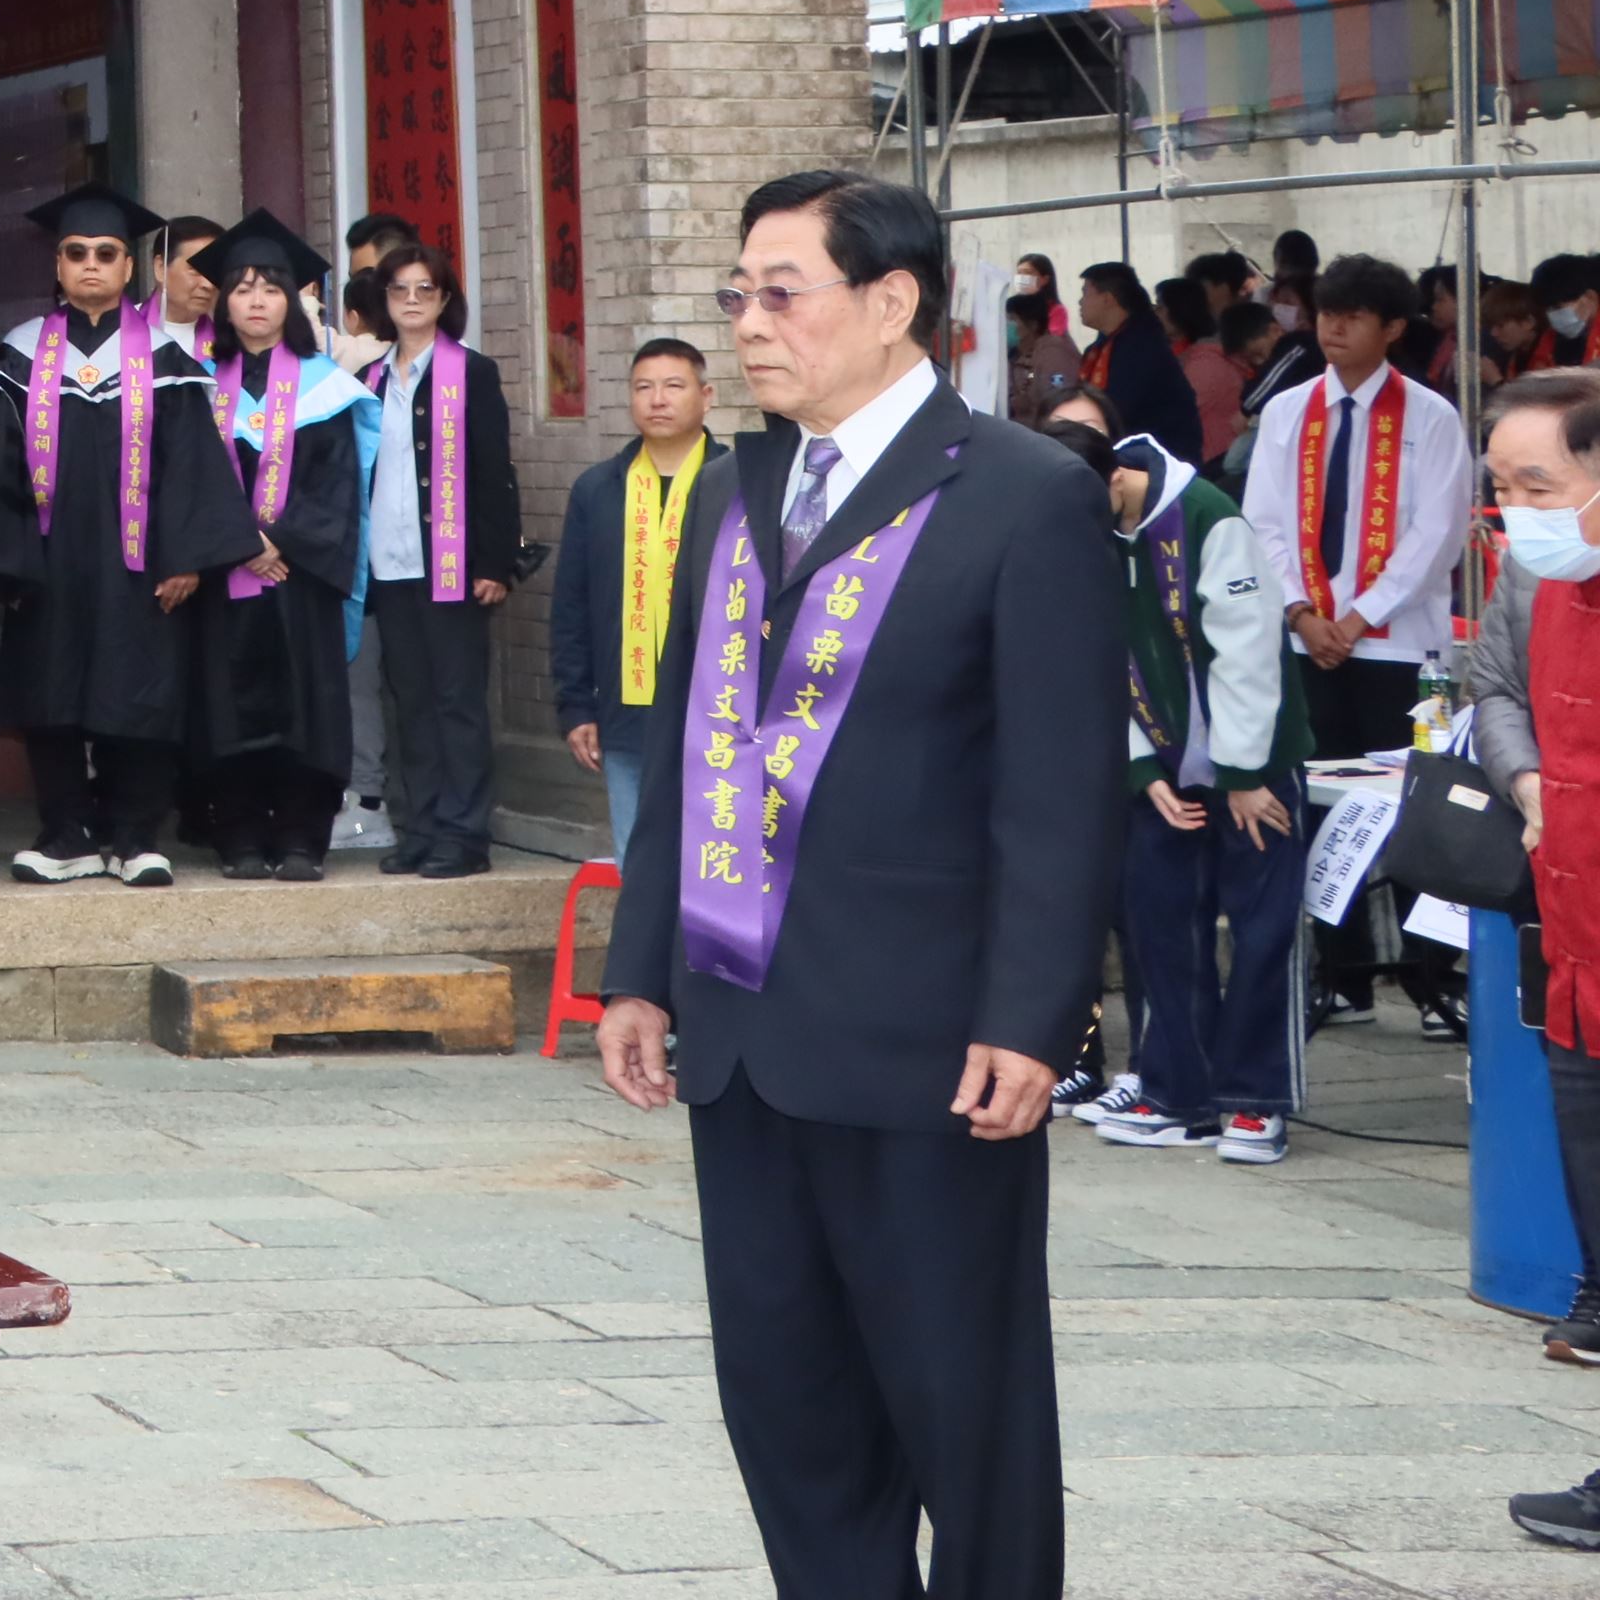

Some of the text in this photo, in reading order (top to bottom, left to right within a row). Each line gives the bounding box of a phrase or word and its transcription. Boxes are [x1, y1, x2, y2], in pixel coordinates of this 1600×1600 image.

[33, 332, 60, 454] 苗栗市文昌祠
[125, 357, 146, 507] ML苗栗文昌書院
[440, 384, 459, 539] ML苗栗文昌書院
[1364, 415, 1394, 588] 苗栗市文昌祠慶
[698, 514, 752, 886] L苗栗文昌書院
